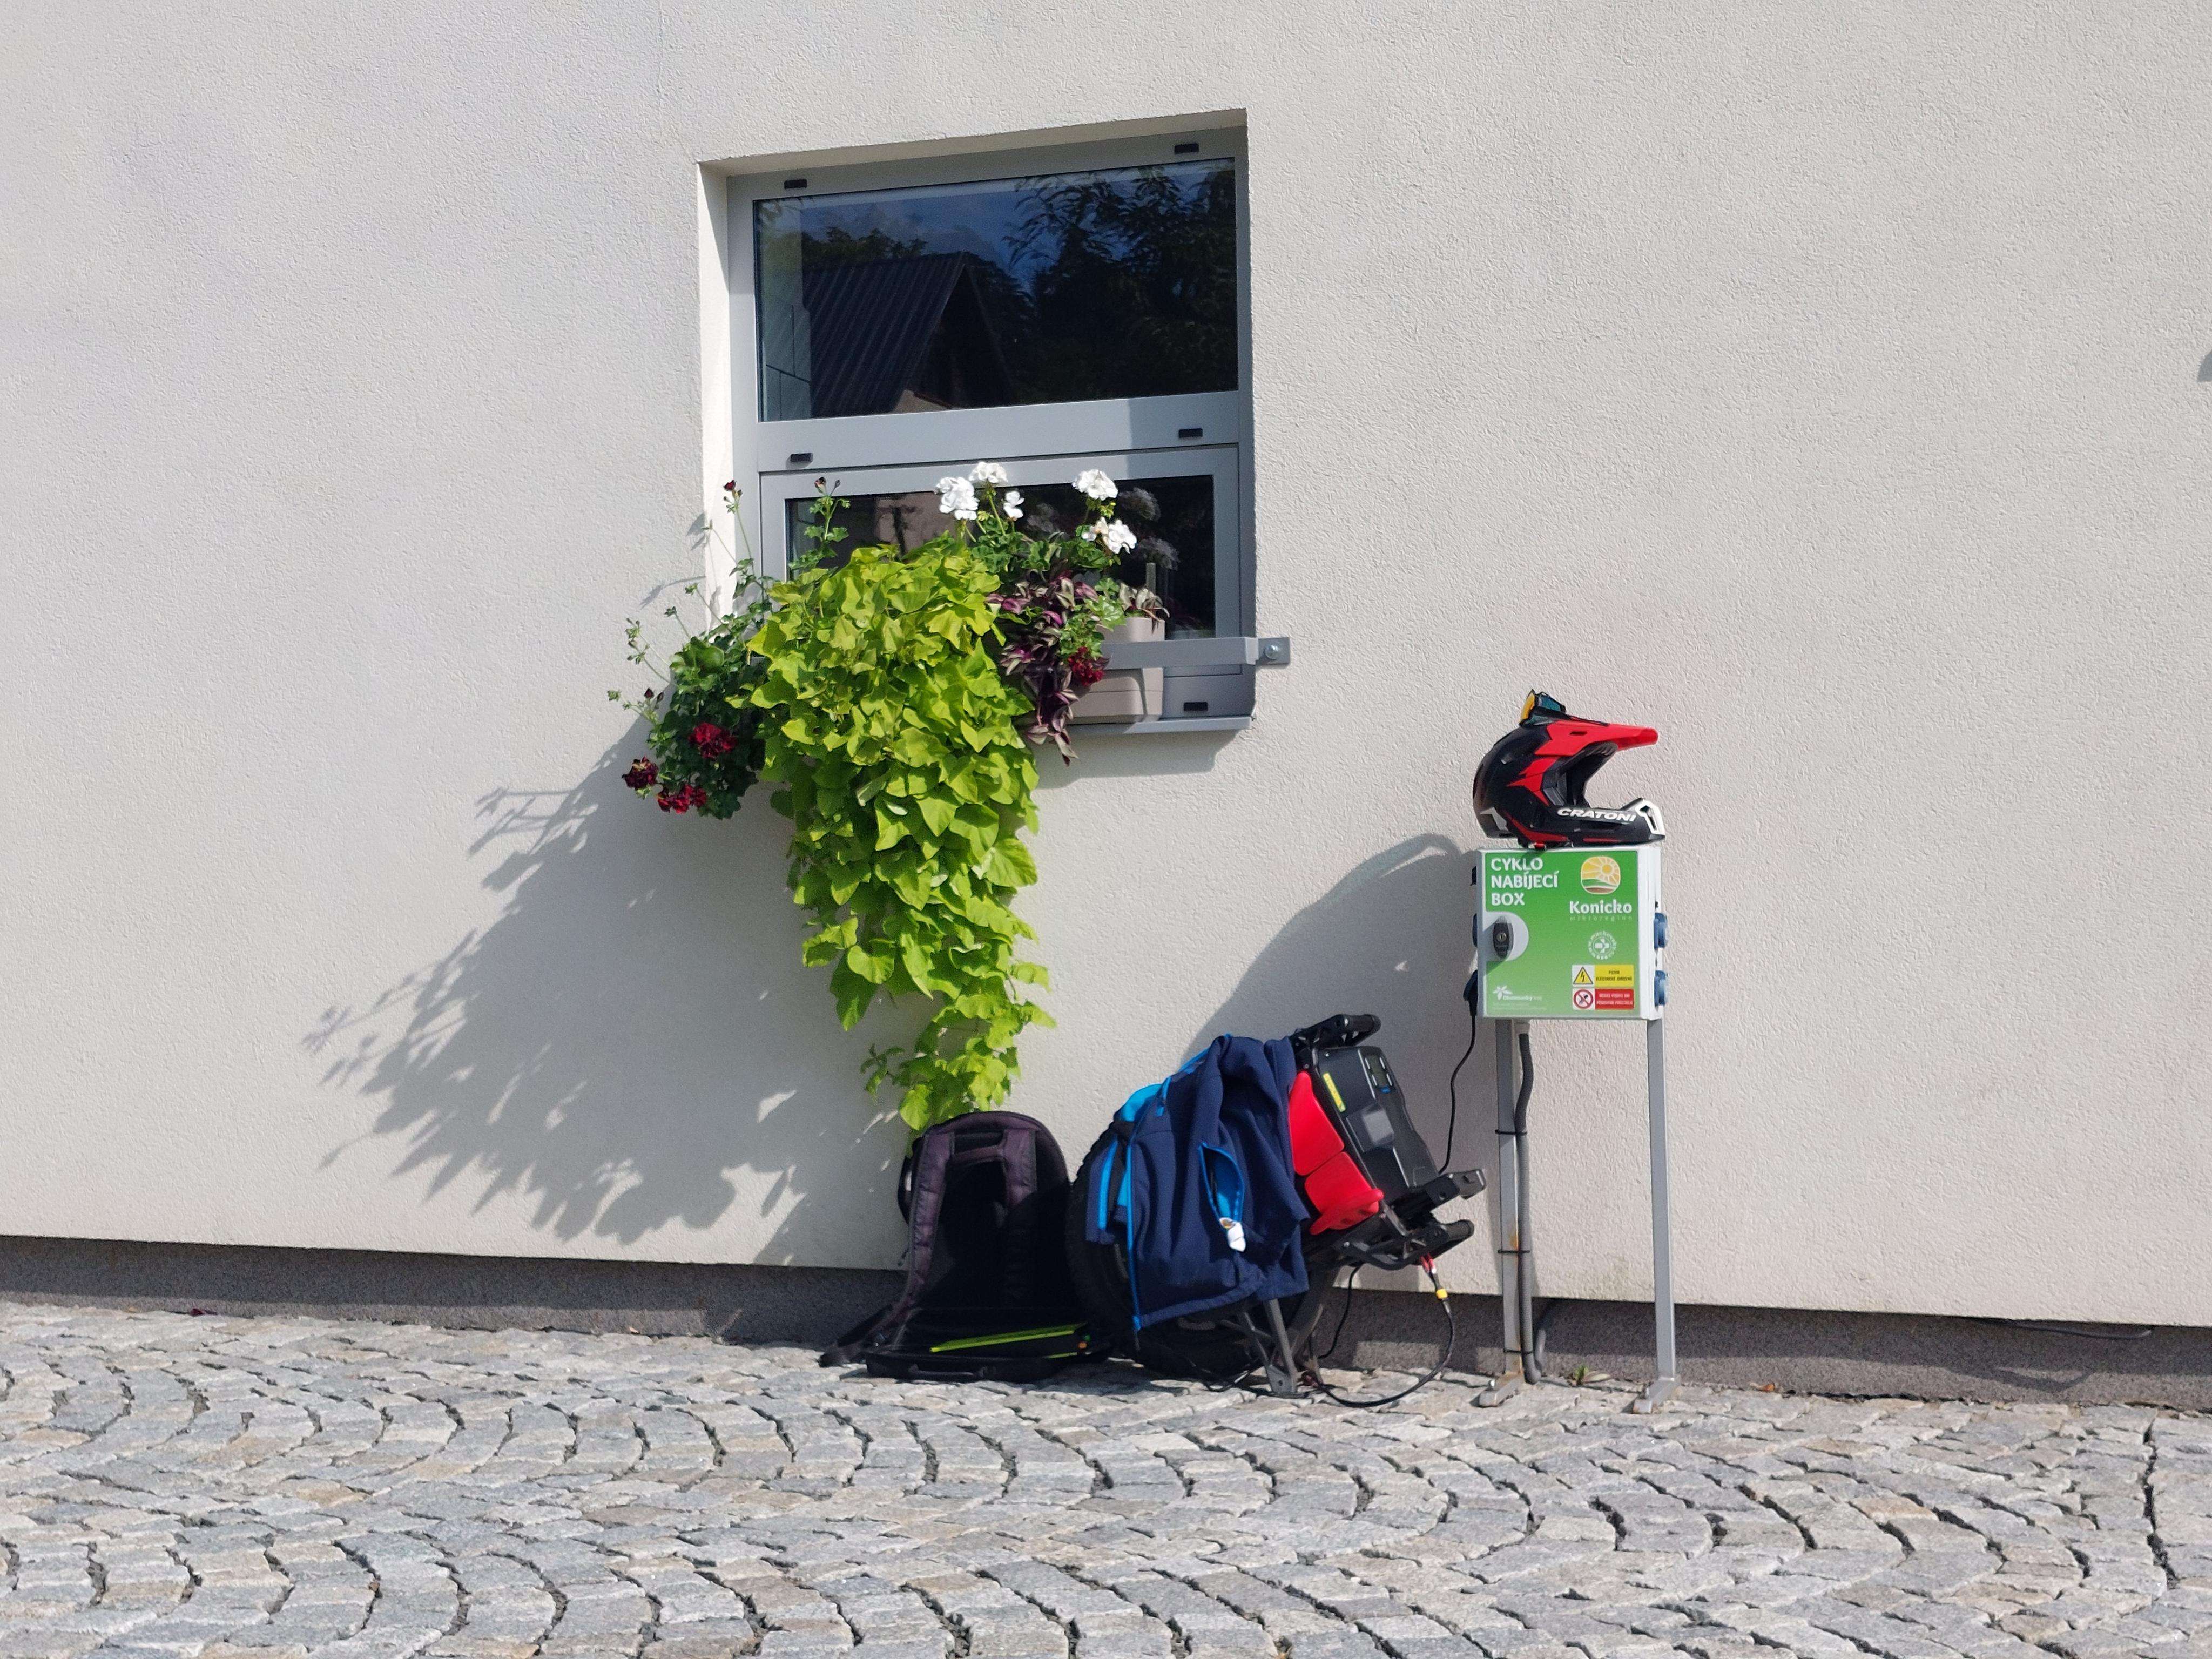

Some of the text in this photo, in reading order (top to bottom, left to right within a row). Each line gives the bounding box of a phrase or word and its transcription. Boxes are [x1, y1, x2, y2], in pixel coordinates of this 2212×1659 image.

[1557, 808, 1636, 822] CRATONI
[1491, 857, 1543, 871] CYKLO
[1491, 870, 1560, 890] NABÍJECÍ
[1491, 892, 1525, 906] BOX
[1569, 899, 1633, 914] Konicko
